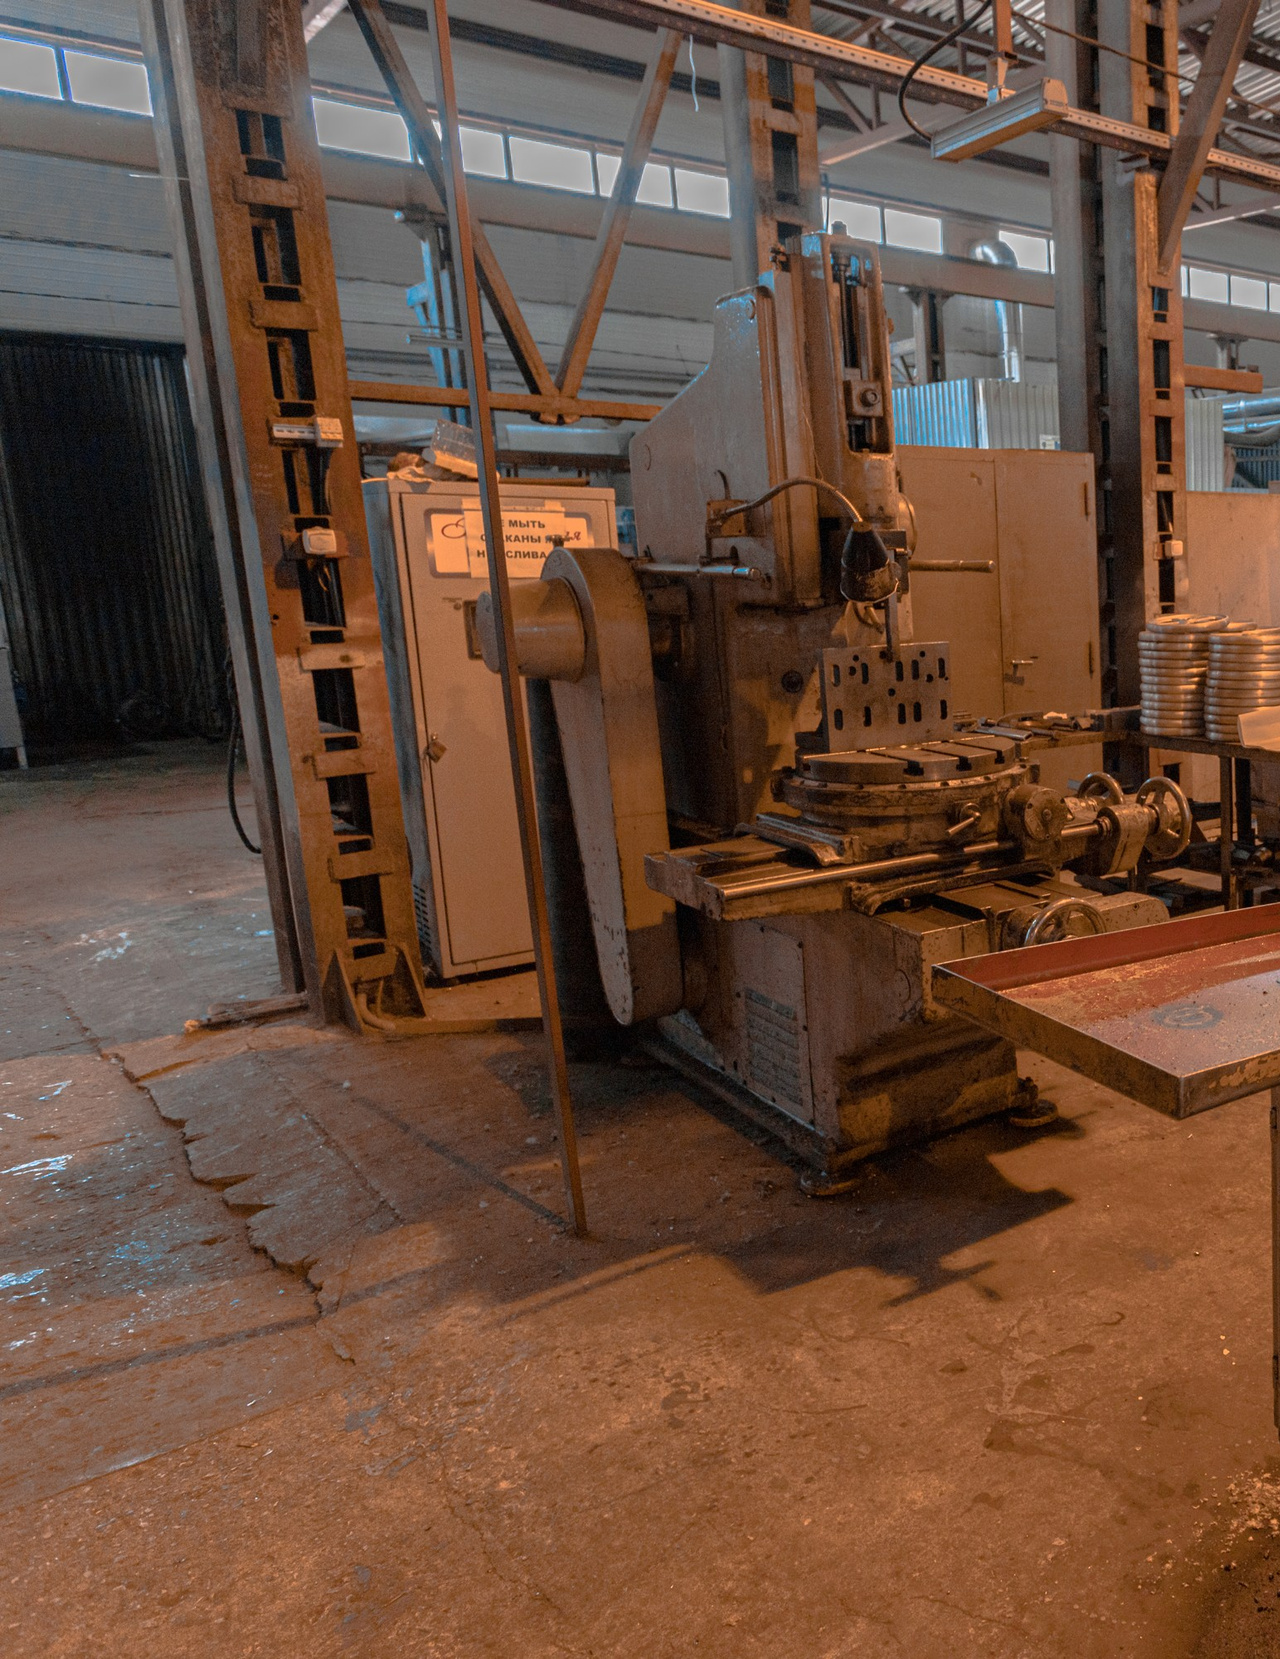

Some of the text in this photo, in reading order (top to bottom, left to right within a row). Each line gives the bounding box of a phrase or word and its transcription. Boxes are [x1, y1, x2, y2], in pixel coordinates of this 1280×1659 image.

[508, 519, 545, 528] МЫТЬ
[480, 533, 541, 543] СКАНЫ
[506, 550, 547, 559] СЛИВА
